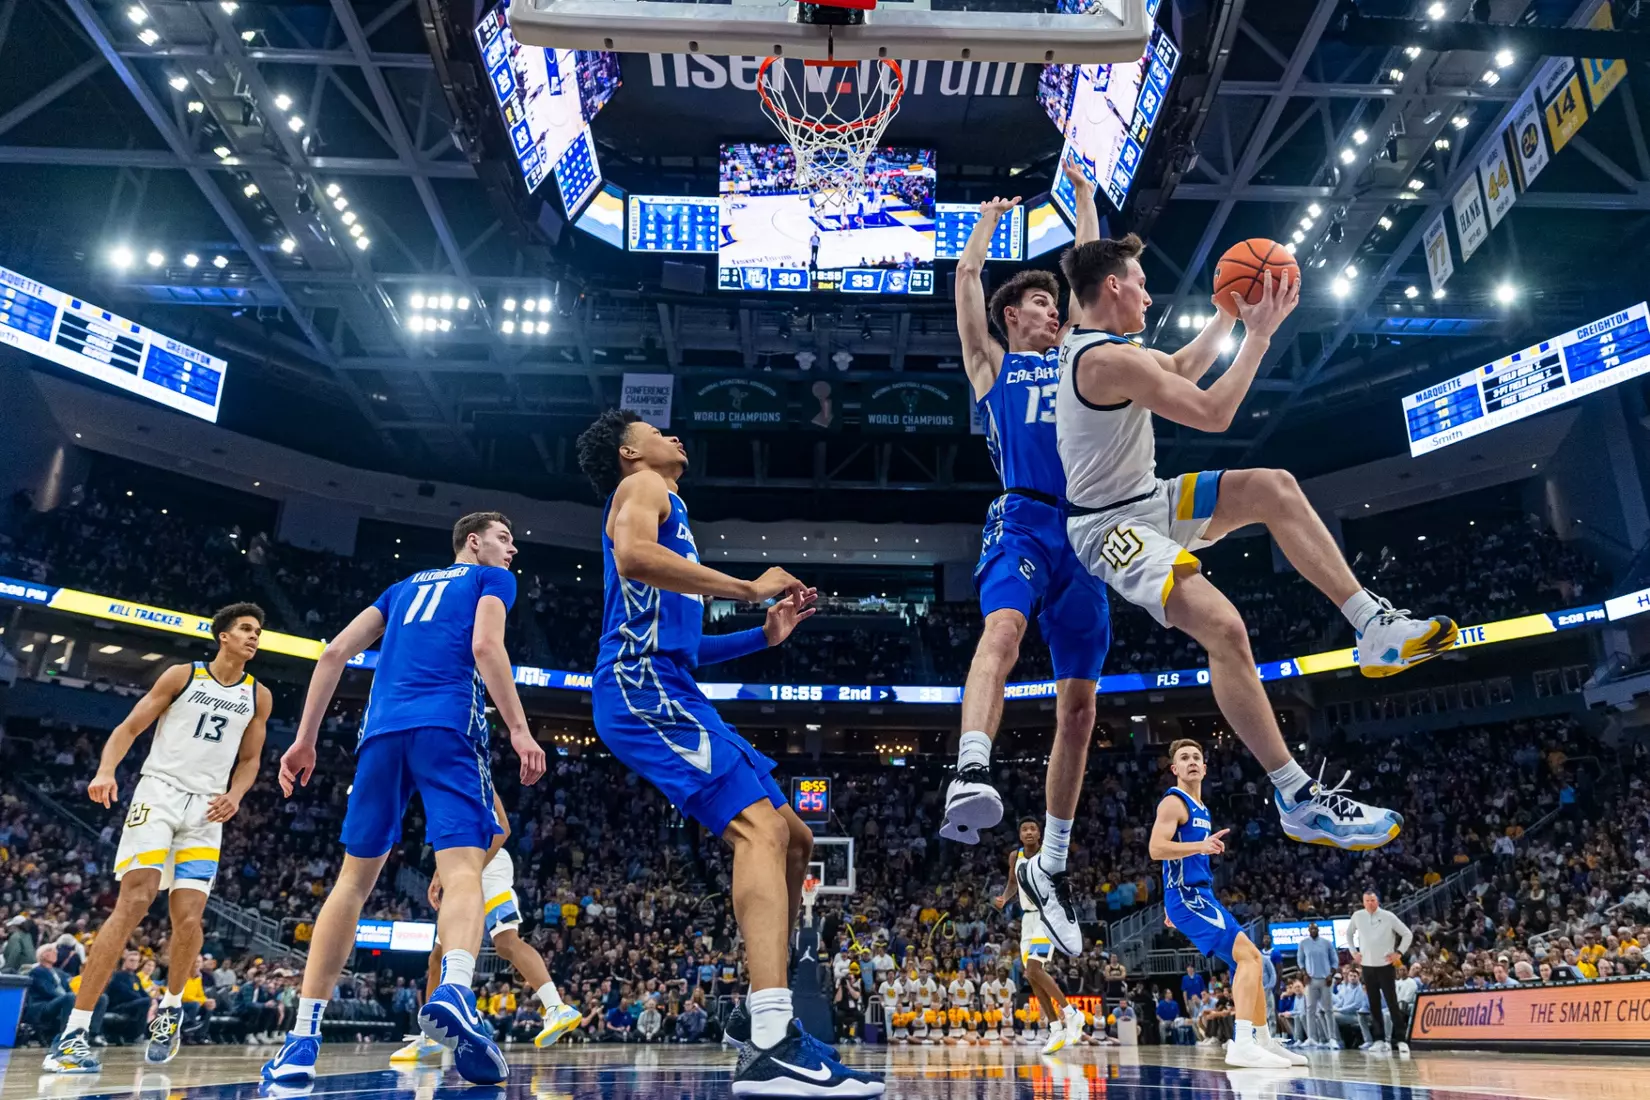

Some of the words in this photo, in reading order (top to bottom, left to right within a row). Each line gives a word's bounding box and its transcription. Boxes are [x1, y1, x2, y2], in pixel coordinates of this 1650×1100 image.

[1553, 85, 1576, 127] 14
[1124, 147, 1137, 167] 30
[1488, 161, 1509, 201] 44
[1459, 196, 1481, 235] HANK
[778, 272, 802, 287] 30
[851, 274, 875, 288] 33
[1577, 311, 1630, 340] CREIGHTON
[1599, 332, 1614, 344] 41
[166, 340, 211, 366] CREIGHTON
[625, 386, 671, 396] CONFERENCE
[625, 395, 668, 405] CHAMPIONS
[1415, 377, 1462, 403] MARQUETTE
[1024, 383, 1059, 424] 13
[693, 411, 726, 422] WORLD
[728, 412, 781, 423] CHAMPIONS
[868, 414, 900, 425] WORLD
[902, 415, 954, 426] CHAMPIONS
[1431, 427, 1463, 448] Smith
[1101, 524, 1145, 573] MU
[403, 580, 451, 626] 11
[108, 603, 131, 617] KILL
[134, 608, 184, 627] TRACKER:
[1585, 608, 1606, 621] PM
[1157, 673, 1180, 687] FLS
[1196, 670, 1210, 684] 0
[1279, 662, 1292, 676] 3
[187, 690, 250, 716] Marquette
[769, 685, 823, 701] 18:55
[838, 686, 872, 701] 2nd
[919, 688, 944, 702] 33
[193, 711, 229, 744] 13
[799, 780, 827, 793] 18:55
[799, 792, 823, 811] 25
[1420, 998, 1494, 1034] Continental
[1530, 1003, 1557, 1024] THE
[1559, 1000, 1613, 1023] SMART
